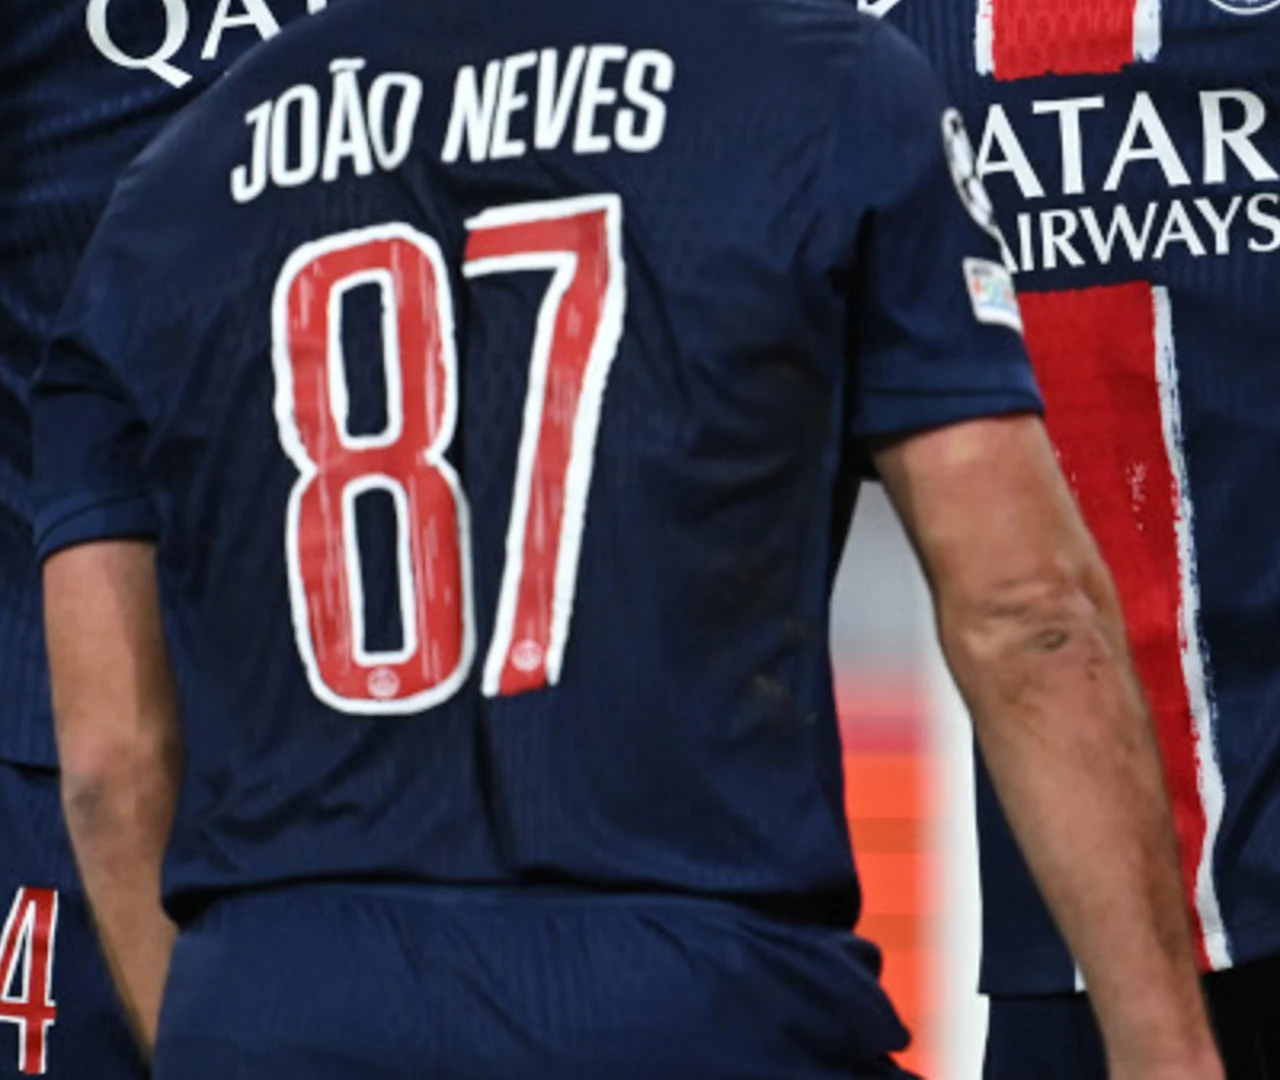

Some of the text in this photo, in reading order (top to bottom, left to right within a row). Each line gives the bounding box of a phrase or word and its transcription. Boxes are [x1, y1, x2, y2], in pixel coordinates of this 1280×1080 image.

[231, 45, 674, 203] JOÃO NEVES
[975, 90, 1280, 198] ATAR
[271, 193, 627, 715] 87
